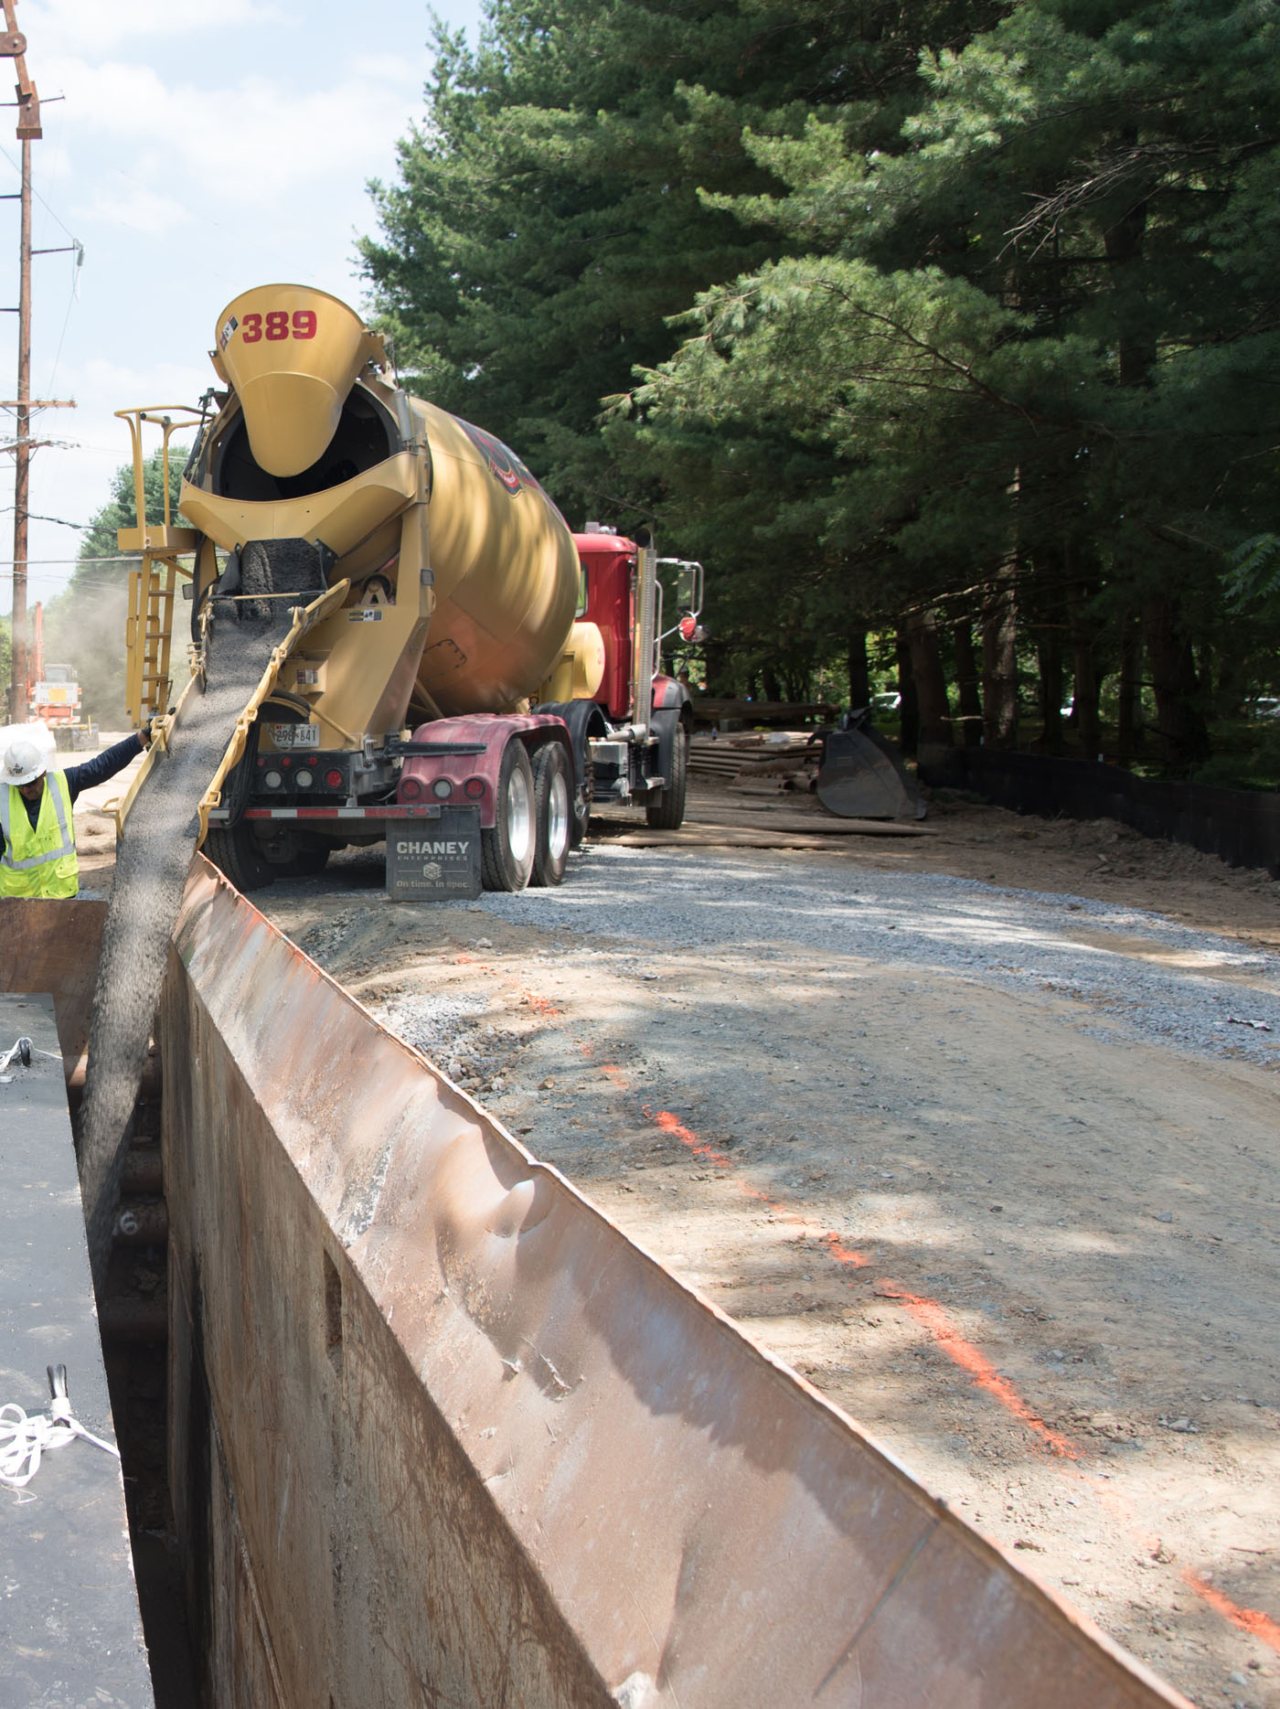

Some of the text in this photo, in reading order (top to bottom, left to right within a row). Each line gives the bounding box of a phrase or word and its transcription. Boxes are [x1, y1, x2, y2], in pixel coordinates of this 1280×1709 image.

[242, 310, 317, 343] 389
[396, 841, 469, 854] CHANEY
[396, 880, 409, 888] On
[411, 879, 434, 888] time.
[446, 881, 471, 890] spec.
[115, 1211, 140, 1236] 6
